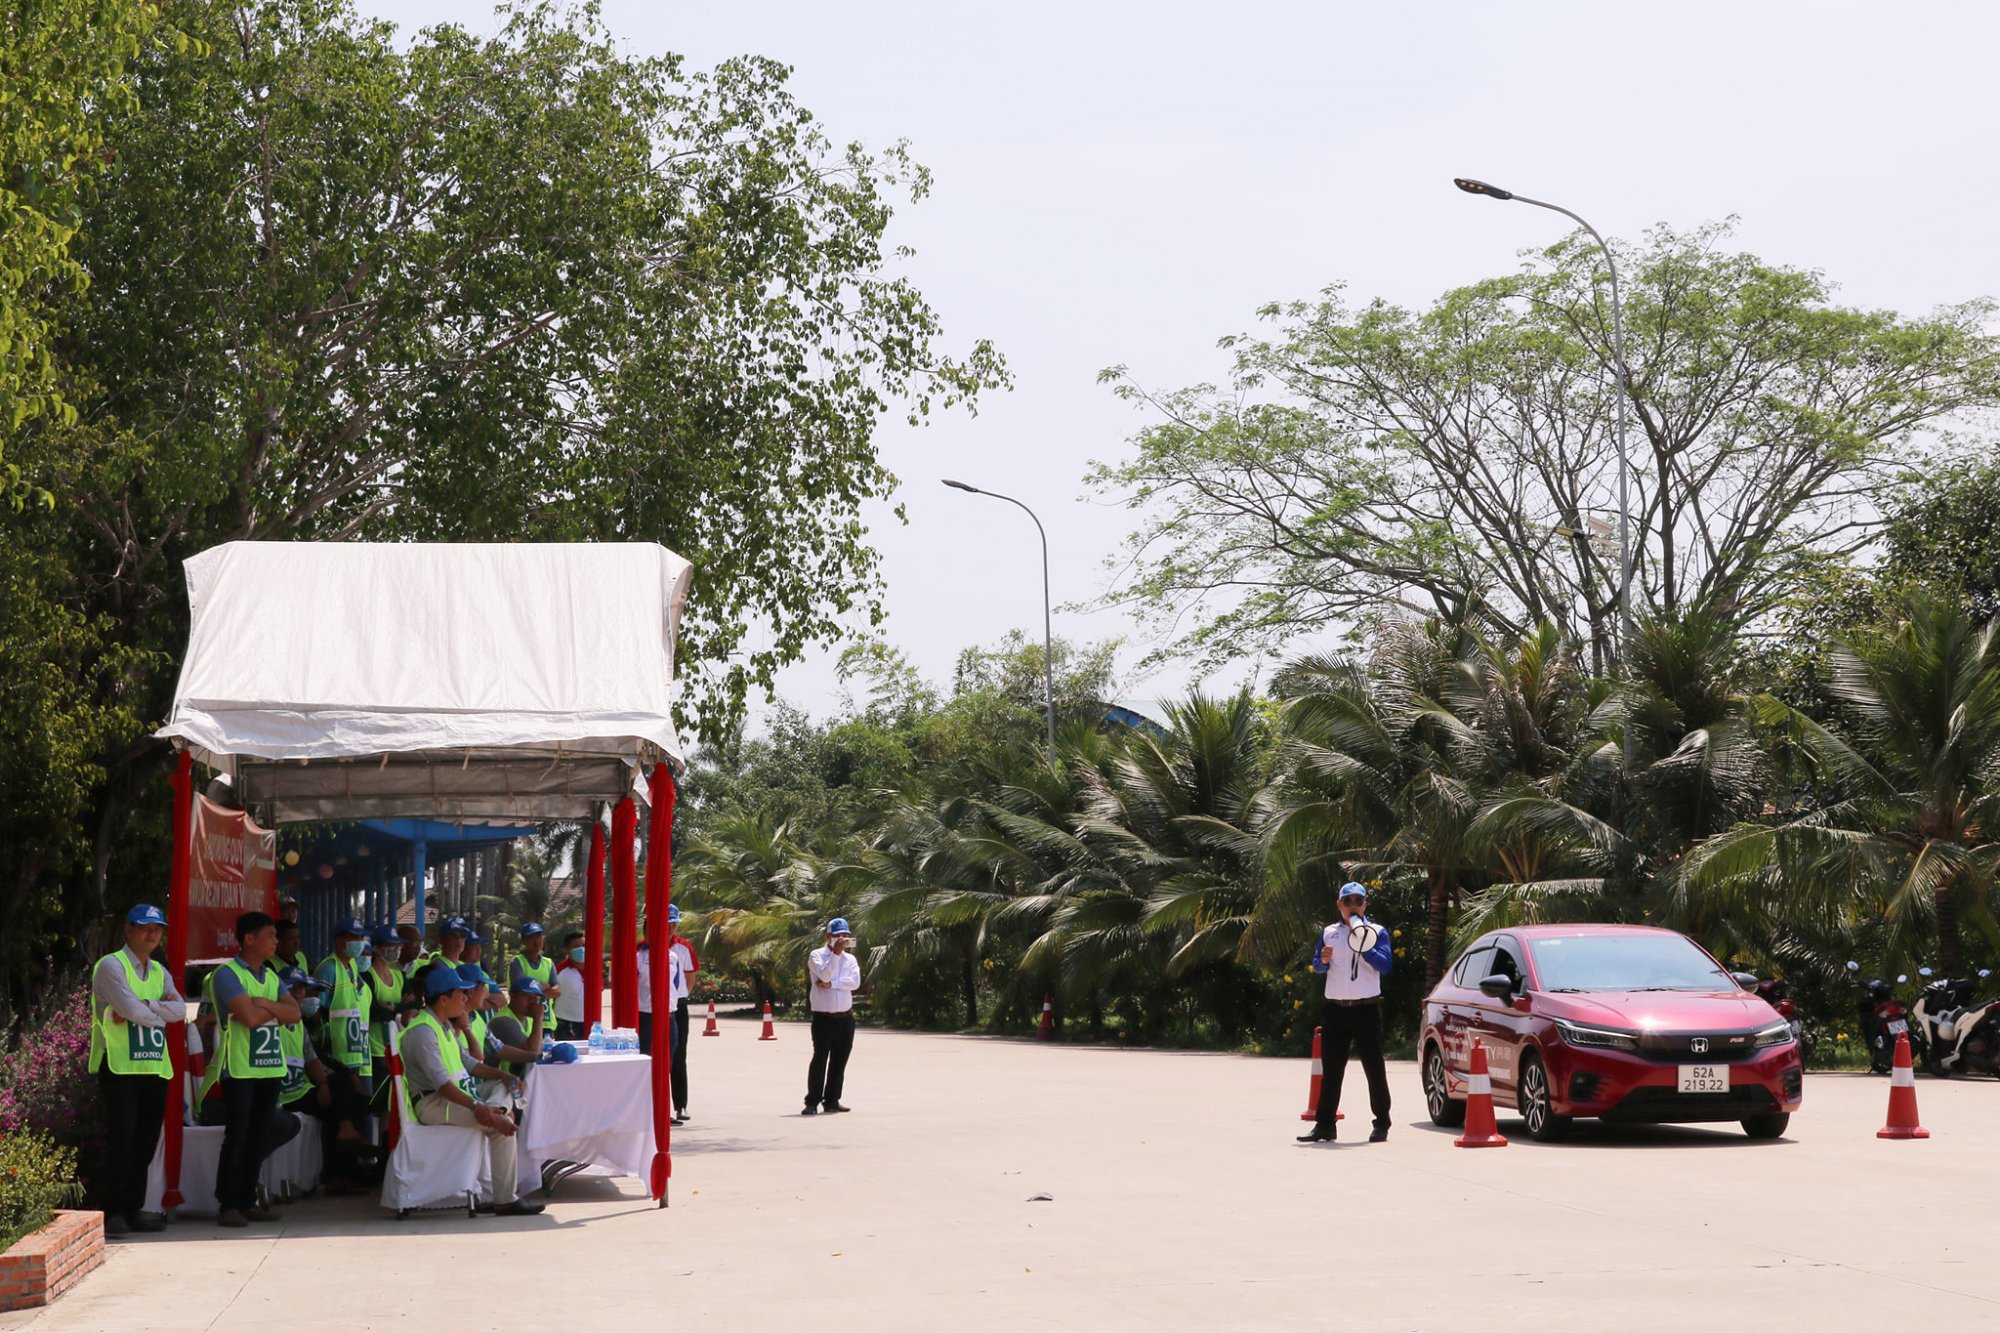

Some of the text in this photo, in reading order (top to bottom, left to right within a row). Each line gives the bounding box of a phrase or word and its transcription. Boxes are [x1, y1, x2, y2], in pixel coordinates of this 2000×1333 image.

[132, 1023, 164, 1047] 16
[255, 1026, 281, 1054] 25
[255, 1058, 281, 1066] HOND
[1693, 1067, 1714, 1078] 62A
[1684, 1080, 1723, 1090] 219.22
